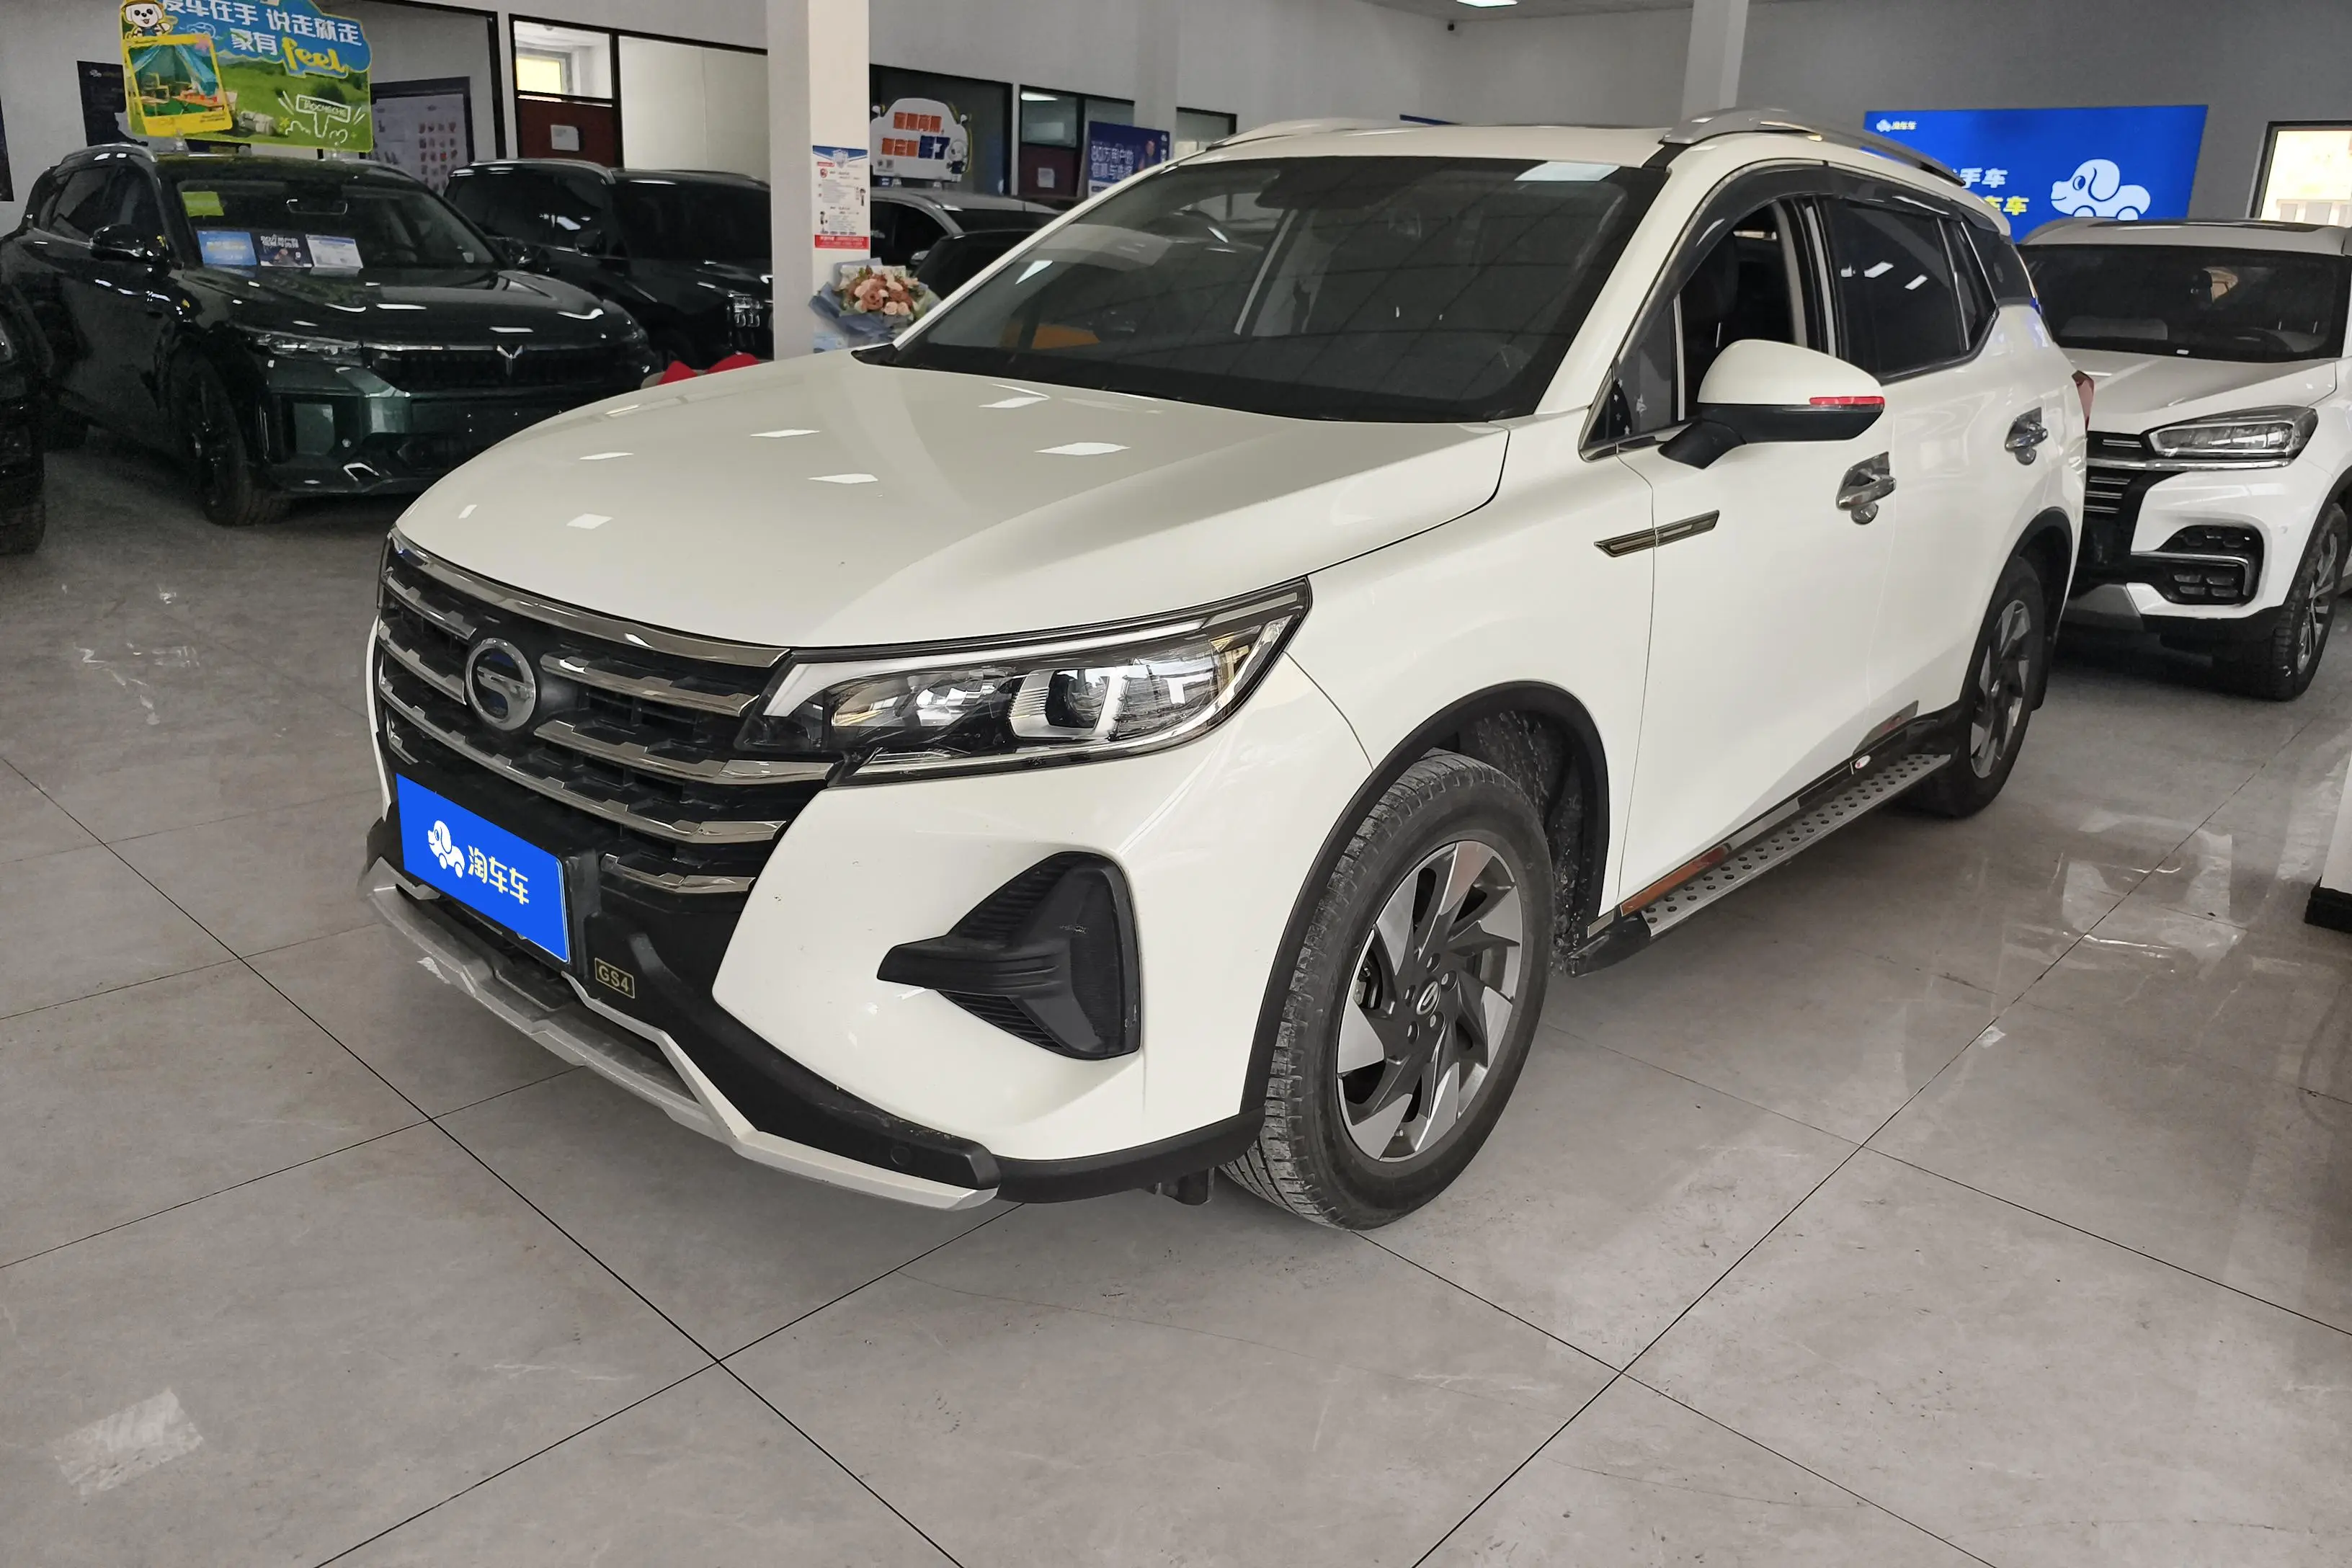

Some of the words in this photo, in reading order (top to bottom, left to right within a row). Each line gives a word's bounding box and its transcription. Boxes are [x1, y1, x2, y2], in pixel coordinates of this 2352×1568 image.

[266, 9, 362, 47] 说走就走
[1953, 167, 2008, 189] 手车
[597, 964, 629, 993] GS4
